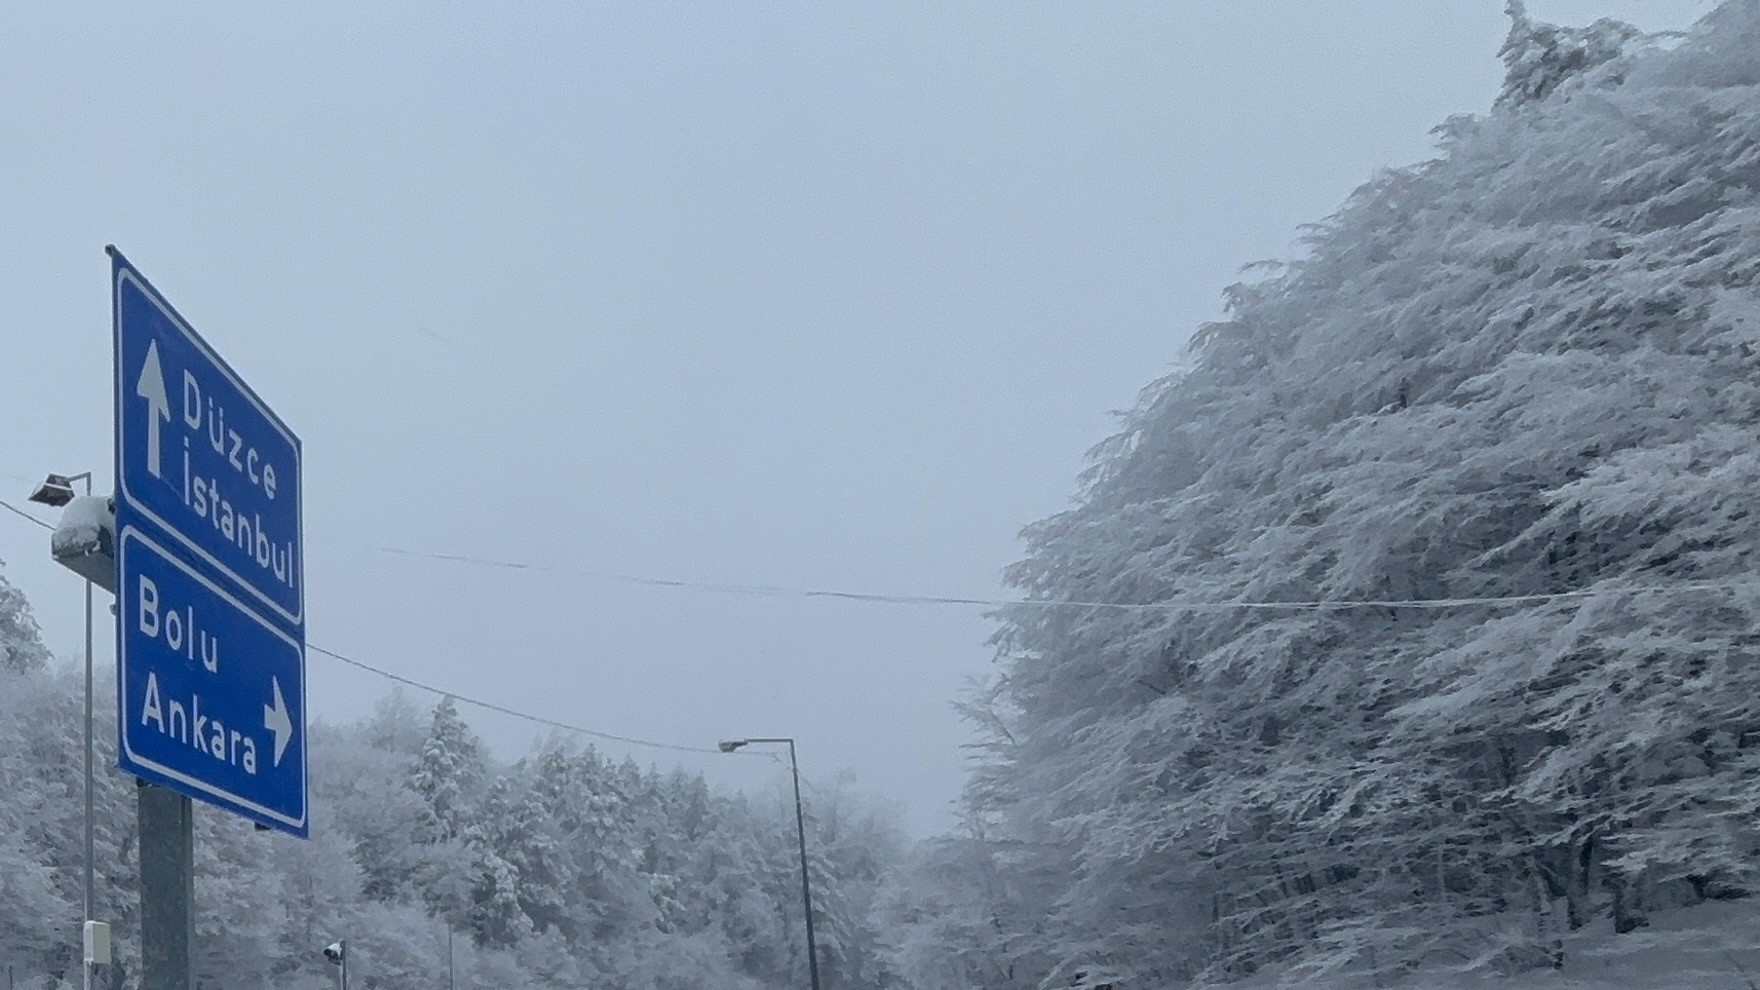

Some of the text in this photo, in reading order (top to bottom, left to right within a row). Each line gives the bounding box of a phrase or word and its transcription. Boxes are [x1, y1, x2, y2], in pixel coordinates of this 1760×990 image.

[183, 368, 277, 500] Düzce
[183, 435, 293, 588] İstanbul
[139, 573, 218, 674] Bolu
[141, 671, 257, 775] Ankara
